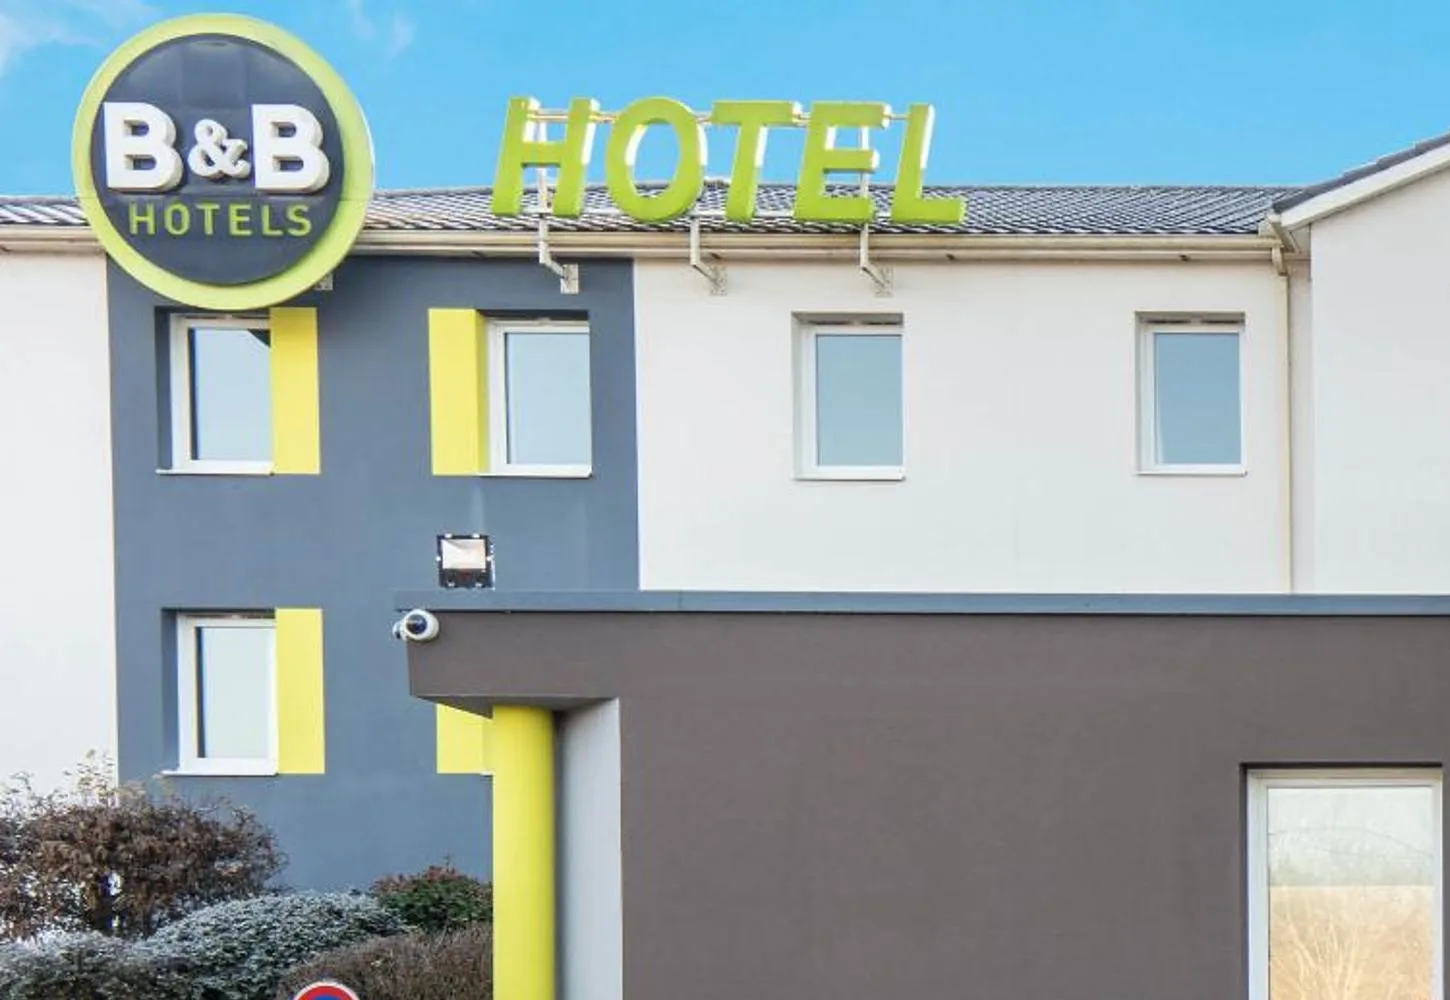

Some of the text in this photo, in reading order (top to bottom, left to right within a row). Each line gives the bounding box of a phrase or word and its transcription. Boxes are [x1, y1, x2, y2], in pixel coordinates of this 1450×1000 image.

[103, 102, 330, 194] B&B
[492, 96, 967, 225] HOTEL
[128, 203, 312, 236] HOTELS
